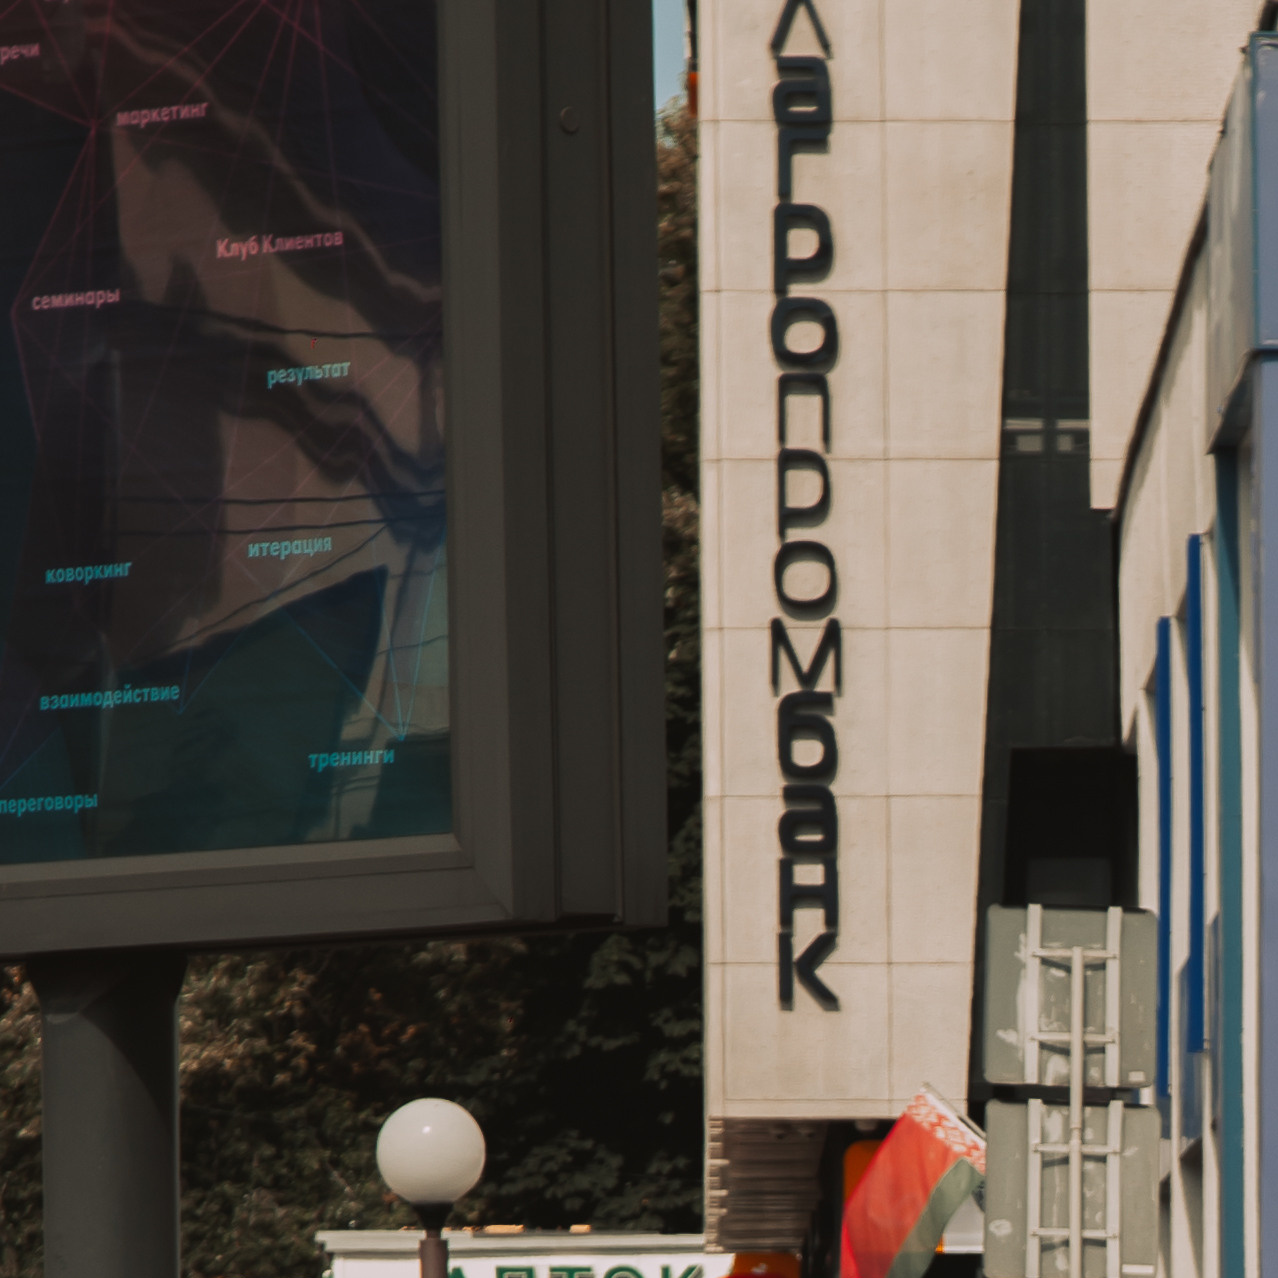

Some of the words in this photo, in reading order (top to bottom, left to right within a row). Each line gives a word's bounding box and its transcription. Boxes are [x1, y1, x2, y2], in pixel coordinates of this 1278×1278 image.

[116, 102, 209, 127] маркетинг
[217, 237, 260, 261] Клуб
[262, 230, 344, 254] Клиентов
[32, 287, 120, 312] семинары
[267, 360, 350, 389] результат
[248, 536, 333, 560] итерация
[45, 562, 131, 586] коворкинг
[40, 684, 180, 711] взаимодействие
[308, 750, 395, 773] тренинги
